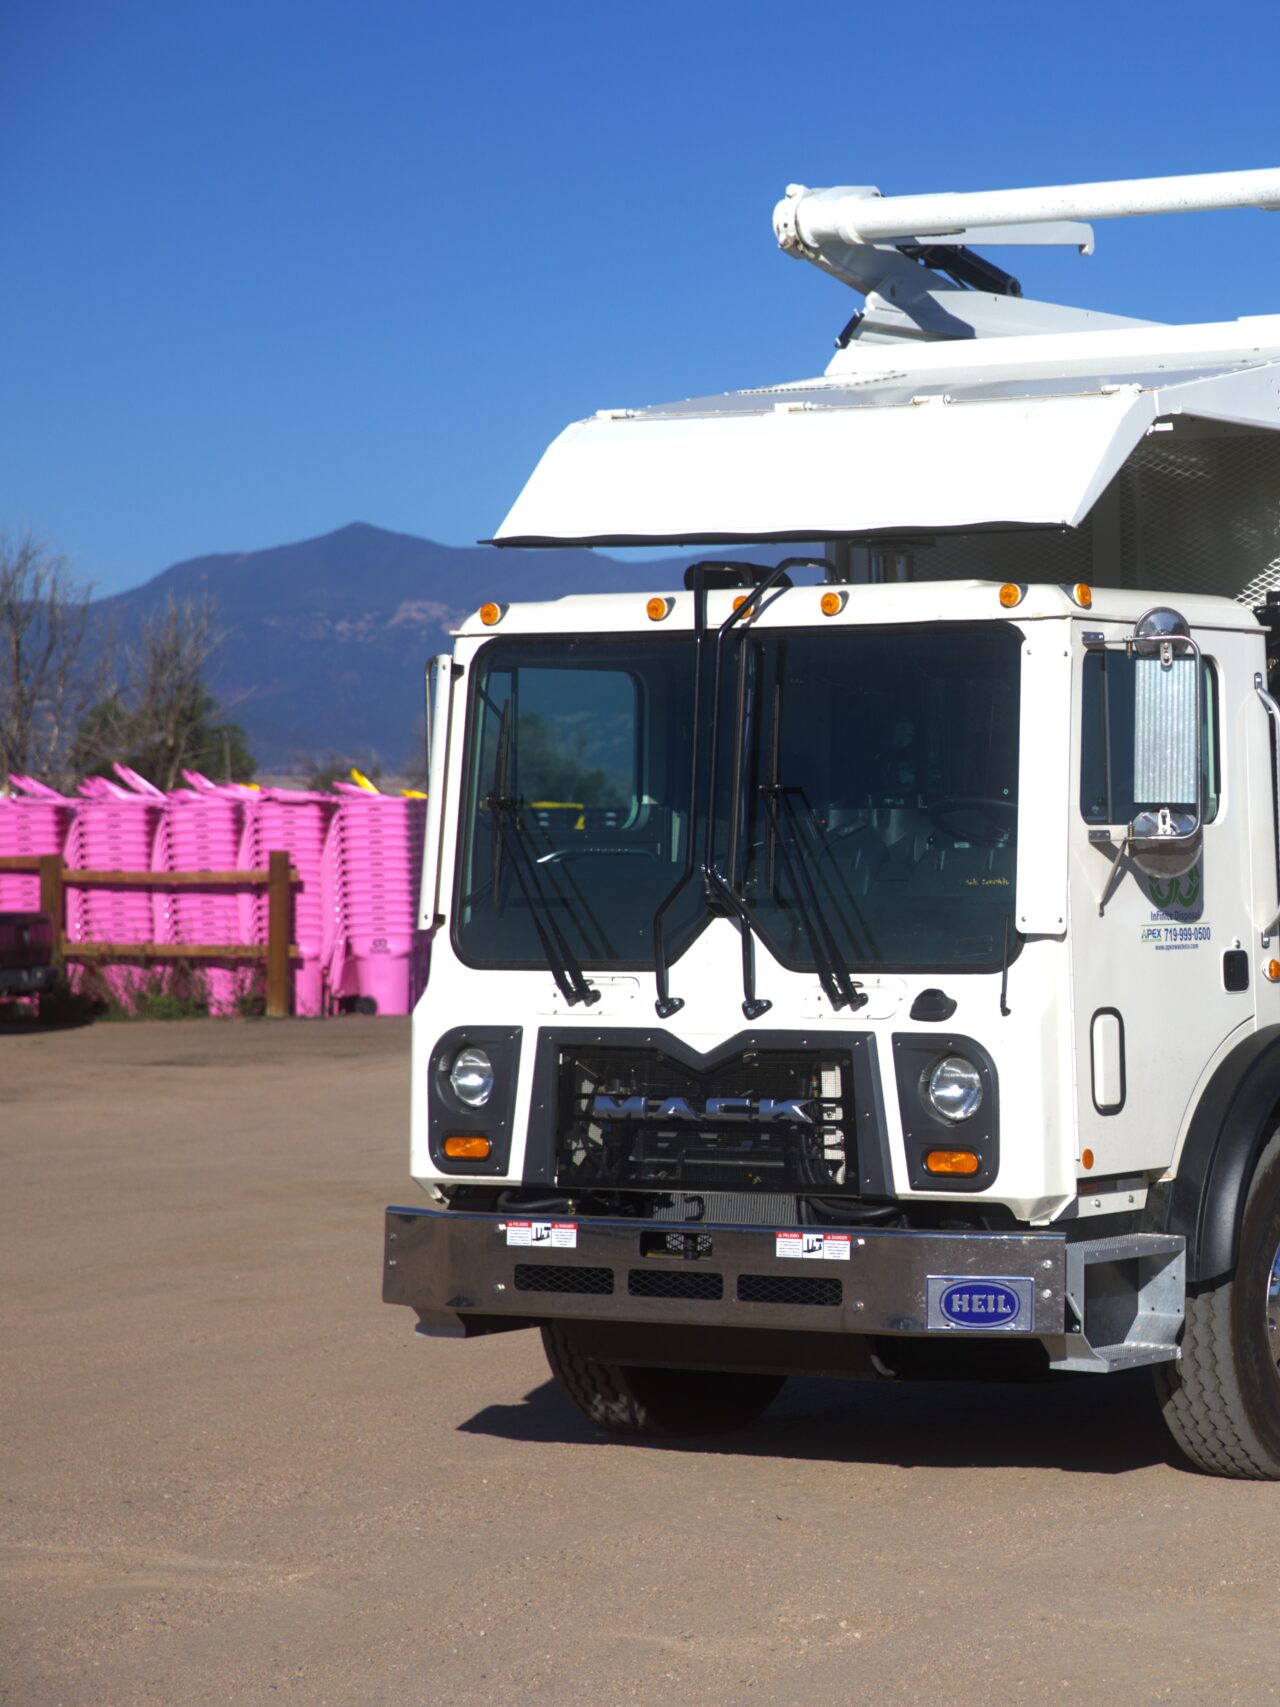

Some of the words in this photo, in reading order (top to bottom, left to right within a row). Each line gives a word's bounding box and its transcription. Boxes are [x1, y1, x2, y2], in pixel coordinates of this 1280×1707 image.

[1141, 928, 1162, 939] APEX
[1164, 927, 1211, 942] 719-999-0500
[592, 1095, 815, 1123] MACK
[951, 1294, 1012, 1313] HEIL
